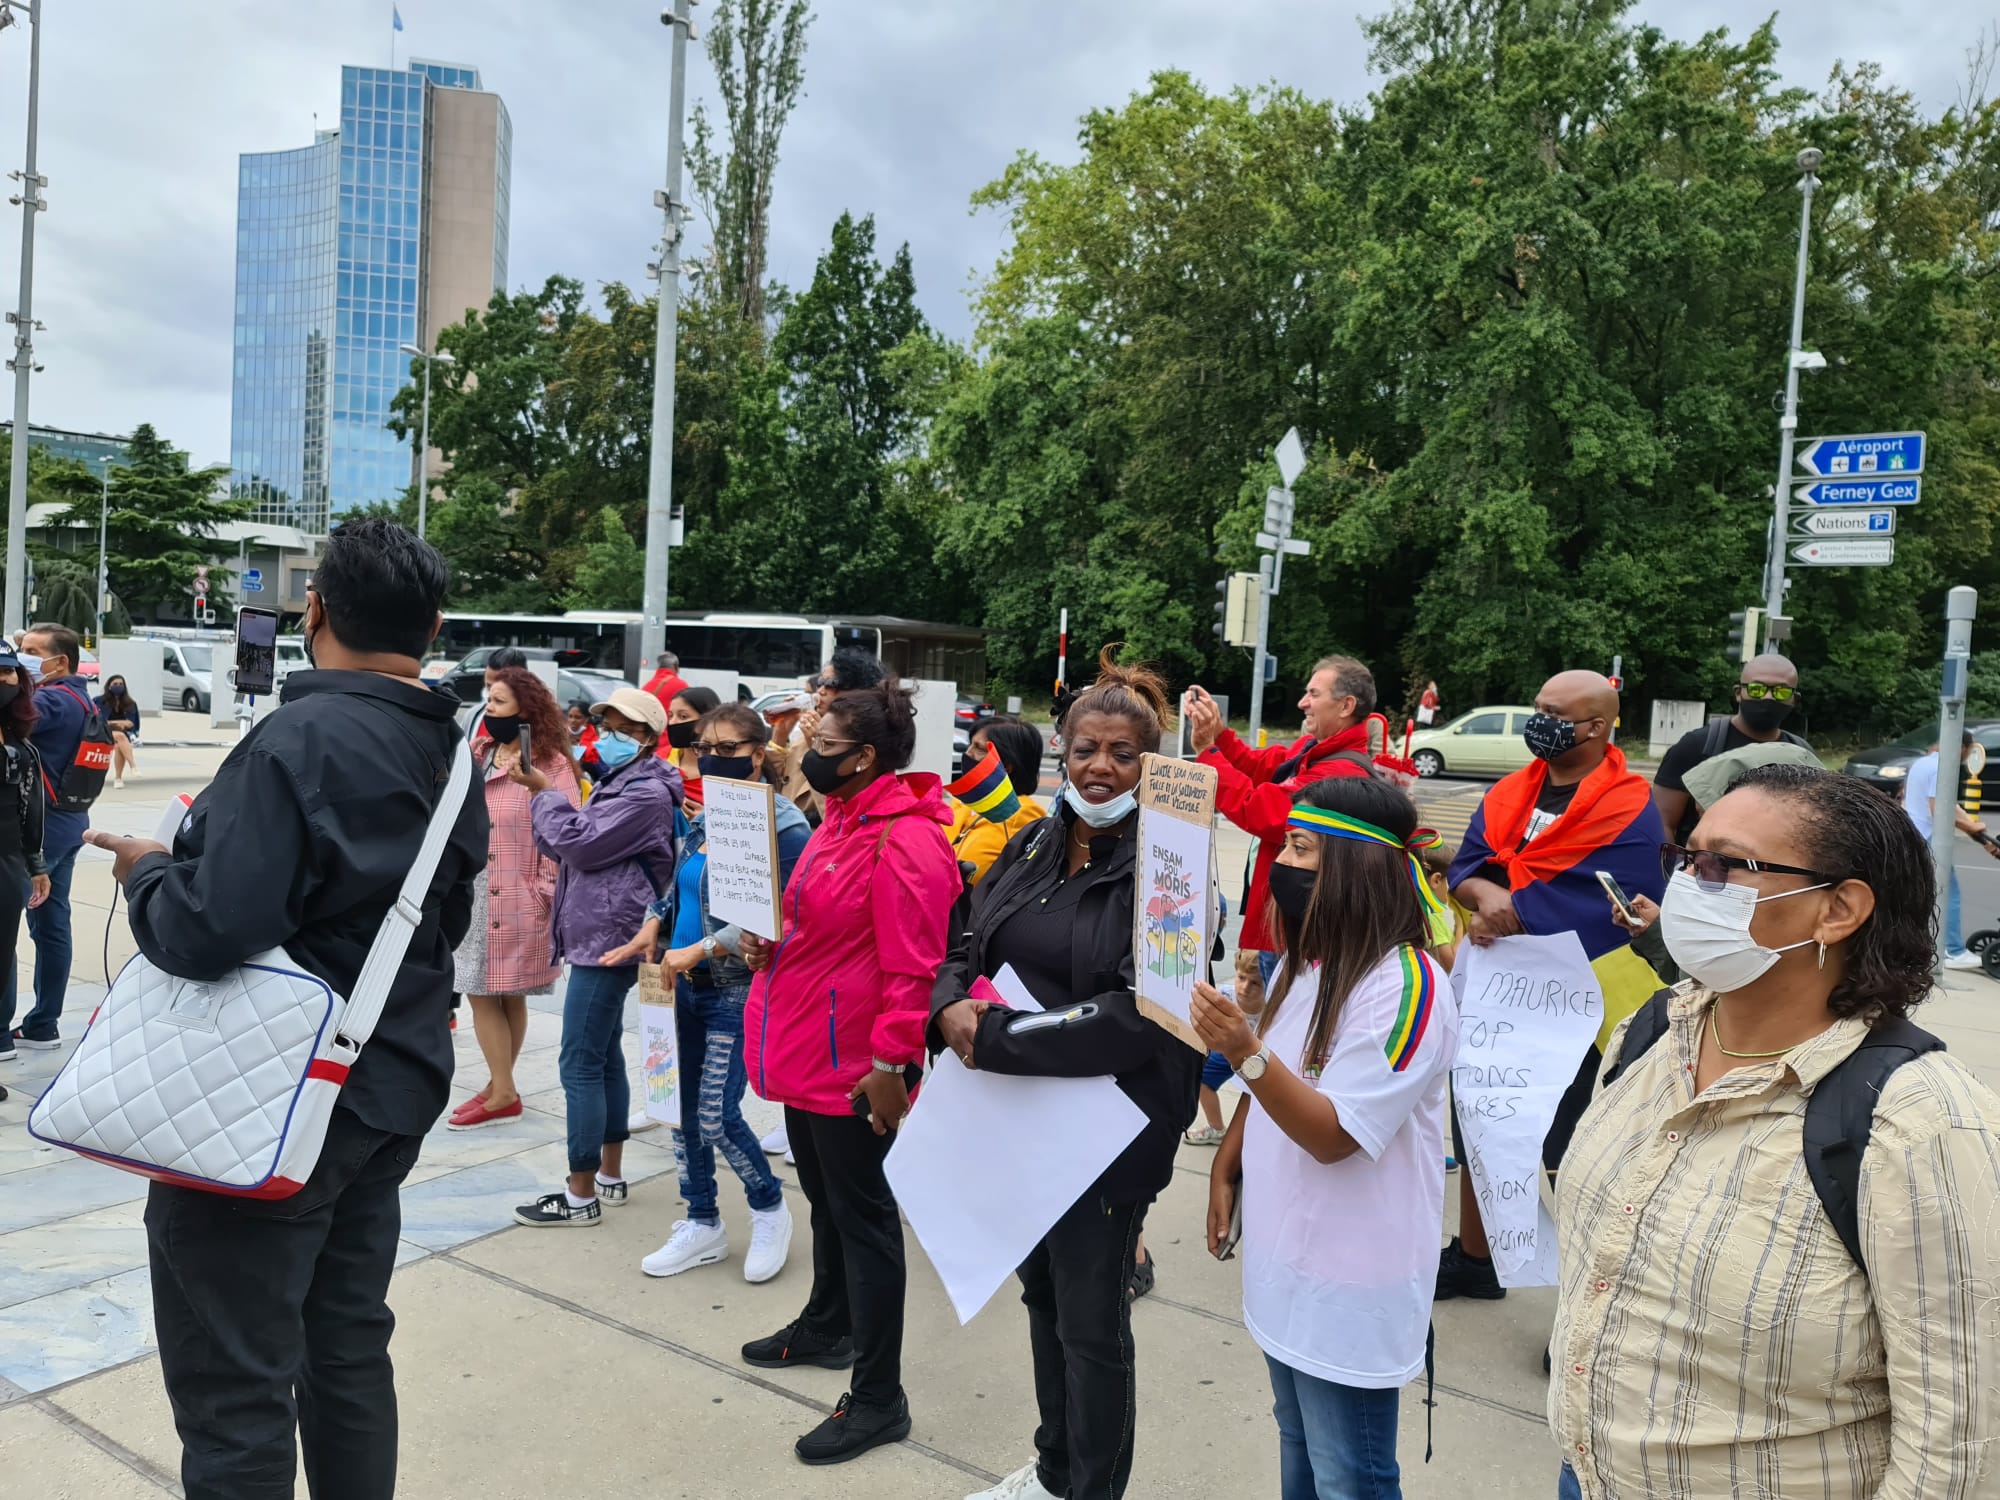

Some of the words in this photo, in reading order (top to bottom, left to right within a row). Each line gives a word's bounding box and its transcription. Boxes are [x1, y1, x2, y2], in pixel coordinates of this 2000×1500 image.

[1837, 439, 1904, 456] Aéroport
[1821, 485, 1876, 503] Ferney
[1881, 482, 1914, 499] Gex
[1816, 517, 1867, 529] Nations
[1152, 844, 1183, 868] ENSAM
[1164, 863, 1178, 876] POU
[1154, 869, 1191, 899] MORIS
